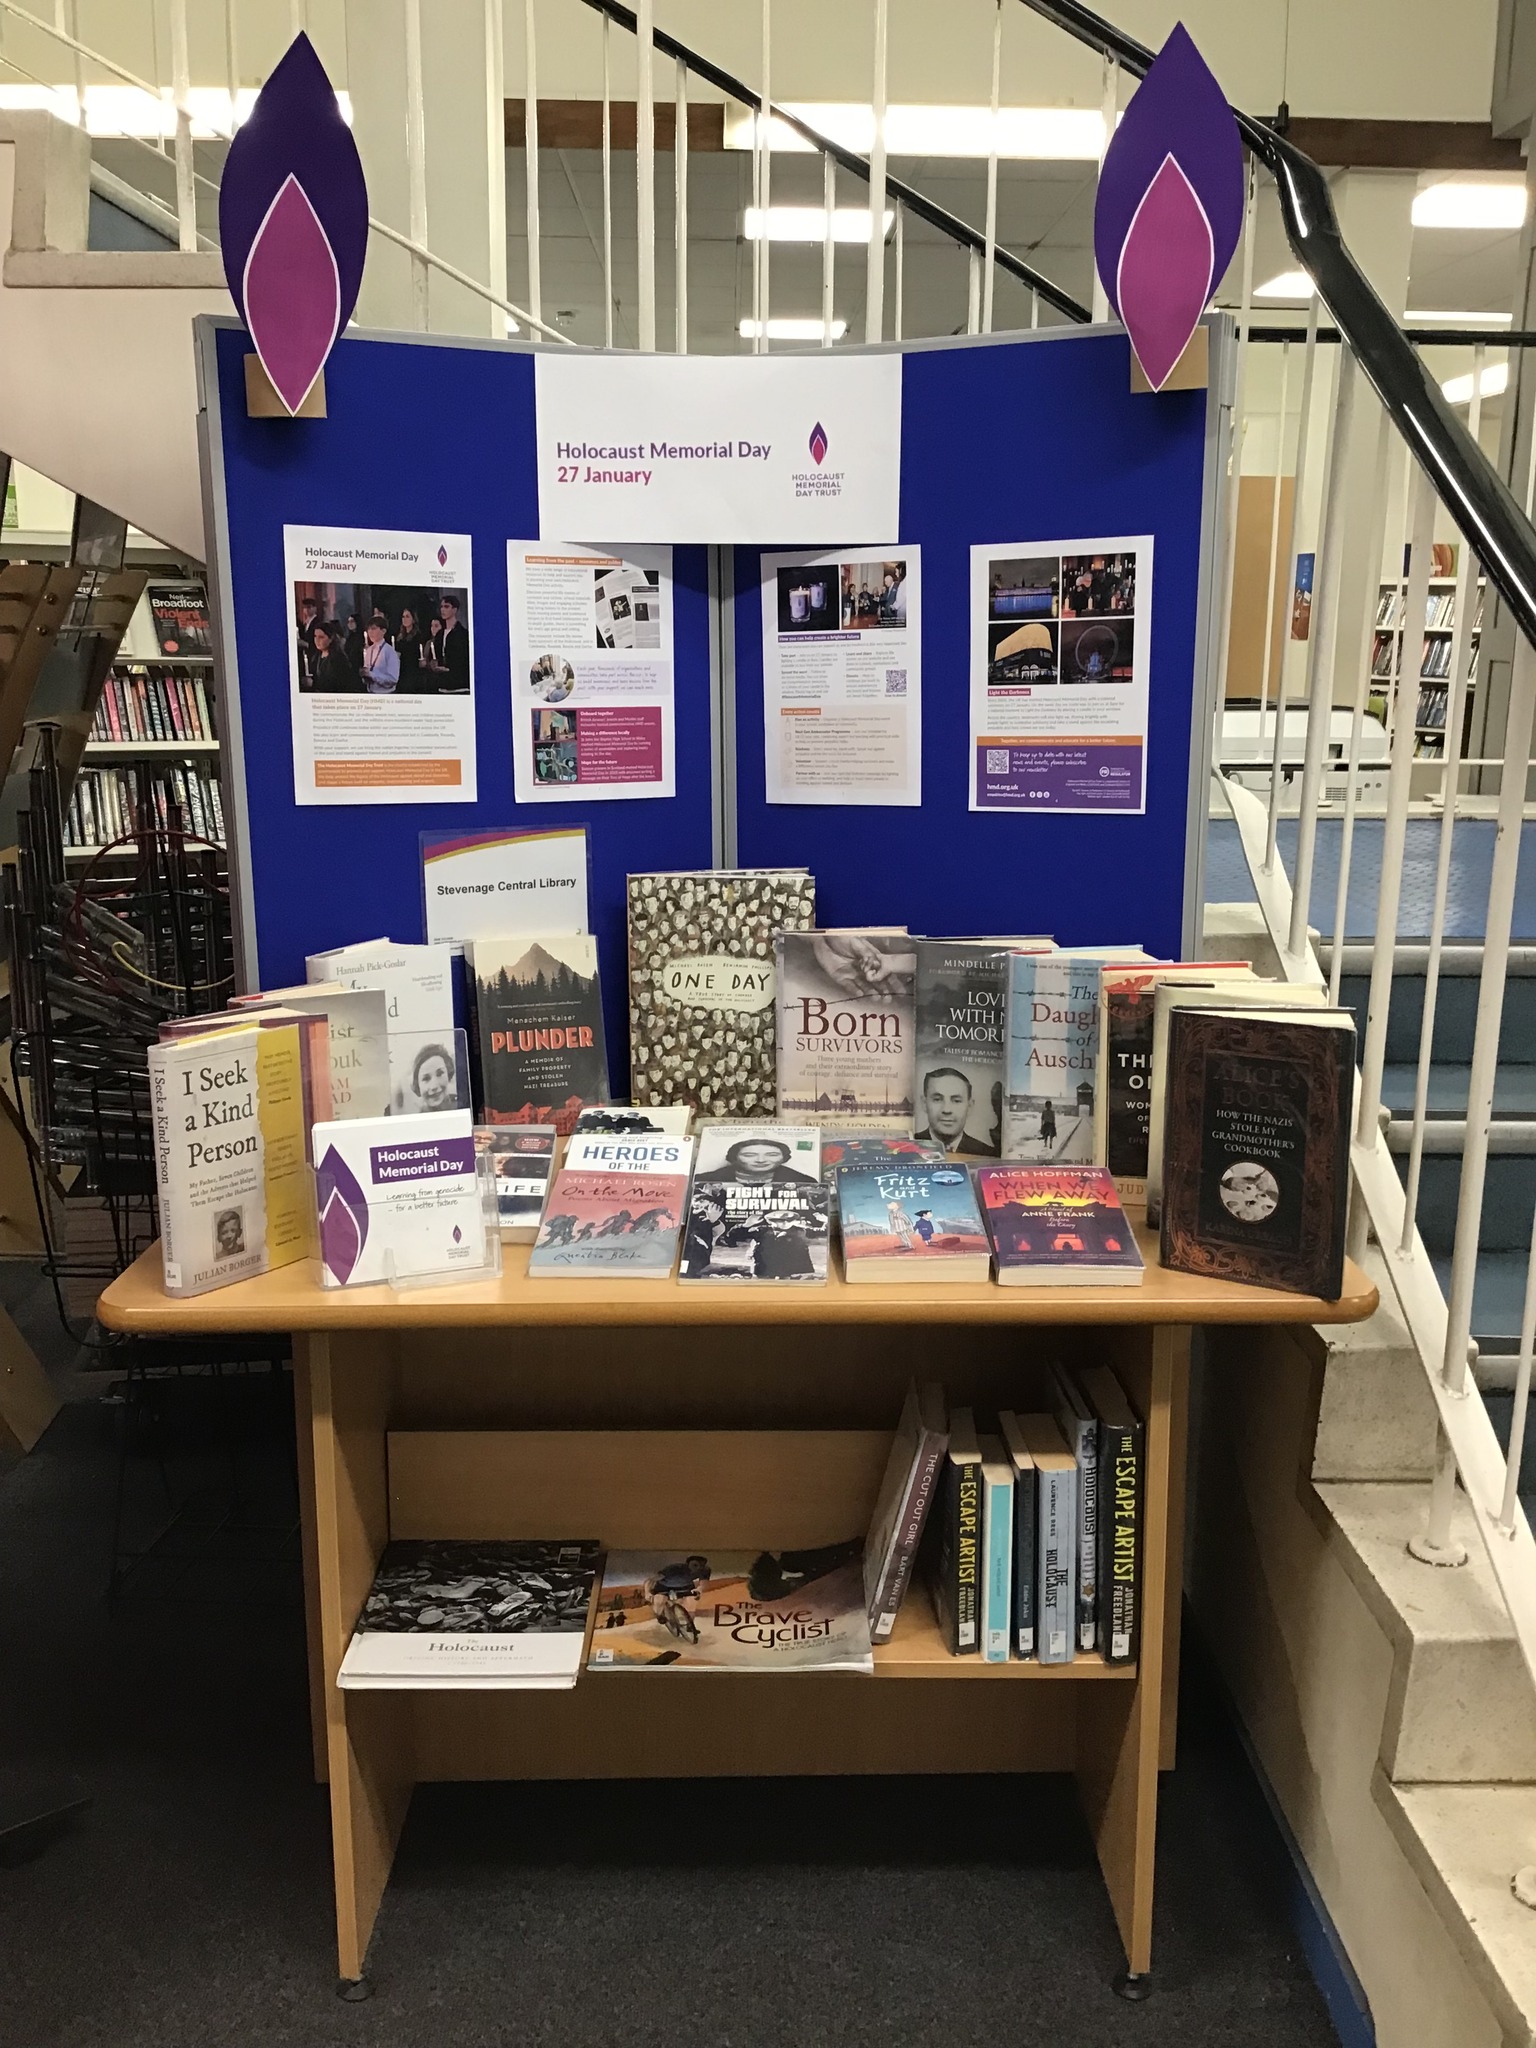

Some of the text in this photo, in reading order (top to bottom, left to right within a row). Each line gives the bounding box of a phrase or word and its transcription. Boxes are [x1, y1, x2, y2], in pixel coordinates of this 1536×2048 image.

[557, 442, 771, 460] Holocaust Memorial Day
[558, 466, 652, 486] 27 January
[792, 473, 844, 481] HOLOCAUST
[796, 481, 841, 489] MEMORIAL
[796, 489, 812, 497] DAY
[305, 548, 418, 562] Holocaust Memorial Day
[306, 561, 356, 572] 27 January
[152, 599, 204, 608] Broadfoot
[155, 609, 200, 619] Violent
[437, 877, 576, 895] Stevenage Central Library
[336, 960, 406, 975] Hannah Pick-Goslar
[944, 959, 996, 970] MINDELLE
[672, 972, 770, 991] ONE DAY
[1072, 986, 1098, 1000] The
[507, 1014, 576, 1025] Menachem Kaiser
[797, 997, 902, 1037] Born
[950, 1008, 994, 1025] WITH
[491, 1026, 594, 1054] PLUNDER
[796, 1038, 902, 1054] SURVIVORS
[1076, 1032, 1094, 1047] of
[1025, 1048, 1094, 1070] Ausch
[183, 1071, 193, 1095] I
[200, 1060, 248, 1092] Seek
[155, 1076, 167, 1102] Seek
[157, 1104, 164, 1112] a
[185, 1094, 254, 1132] a Kind
[1216, 1110, 1293, 1127] HOW THE NAZIS
[158, 1115, 169, 1144] Kind
[1230, 1123, 1277, 1135] STOLE MY
[1212, 1131, 1295, 1149] GRANDMOTHER'S
[188, 1135, 258, 1168] Person
[377, 1147, 439, 1163] Holocaust
[583, 1146, 679, 1161] HEROES
[1224, 1143, 1281, 1158] COOKBOOK
[160, 1146, 170, 1184] Person
[379, 1160, 464, 1178] Memorial Day
[609, 1162, 624, 1170] OF
[874, 1173, 930, 1186] Fritz
[999, 1181, 1098, 1190] WHEN WE
[386, 1184, 464, 1200] Learning from genocide
[562, 1186, 673, 1197] On the Move
[726, 1187, 773, 1198] FIGHT
[880, 1187, 930, 1200] Kurt
[994, 1190, 1109, 1200] FLEW AWAY
[396, 1204, 405, 1212] for
[414, 1201, 434, 1210] better
[437, 1199, 458, 1208] future
[725, 1199, 809, 1210] SURVIVAL
[164, 1199, 173, 1262] JULIAN BORGER
[194, 1254, 261, 1285] JULIAN BORGER
[904, 1454, 937, 1545] THE CUT OUT GIRL
[1113, 1435, 1136, 1582] THE ESCAPE ARTIST
[959, 1465, 976, 1584] THE ESCAPE ARTIST
[888, 1555, 908, 1607] BART VAN ES
[1046, 1549, 1058, 1608] HOLOCAUST
[1057, 1568, 1068, 1586] THE
[736, 1602, 762, 1610] The
[714, 1604, 812, 1626] Brave
[731, 1618, 835, 1648] Cyclist
[428, 1643, 514, 1651] Holocaust
